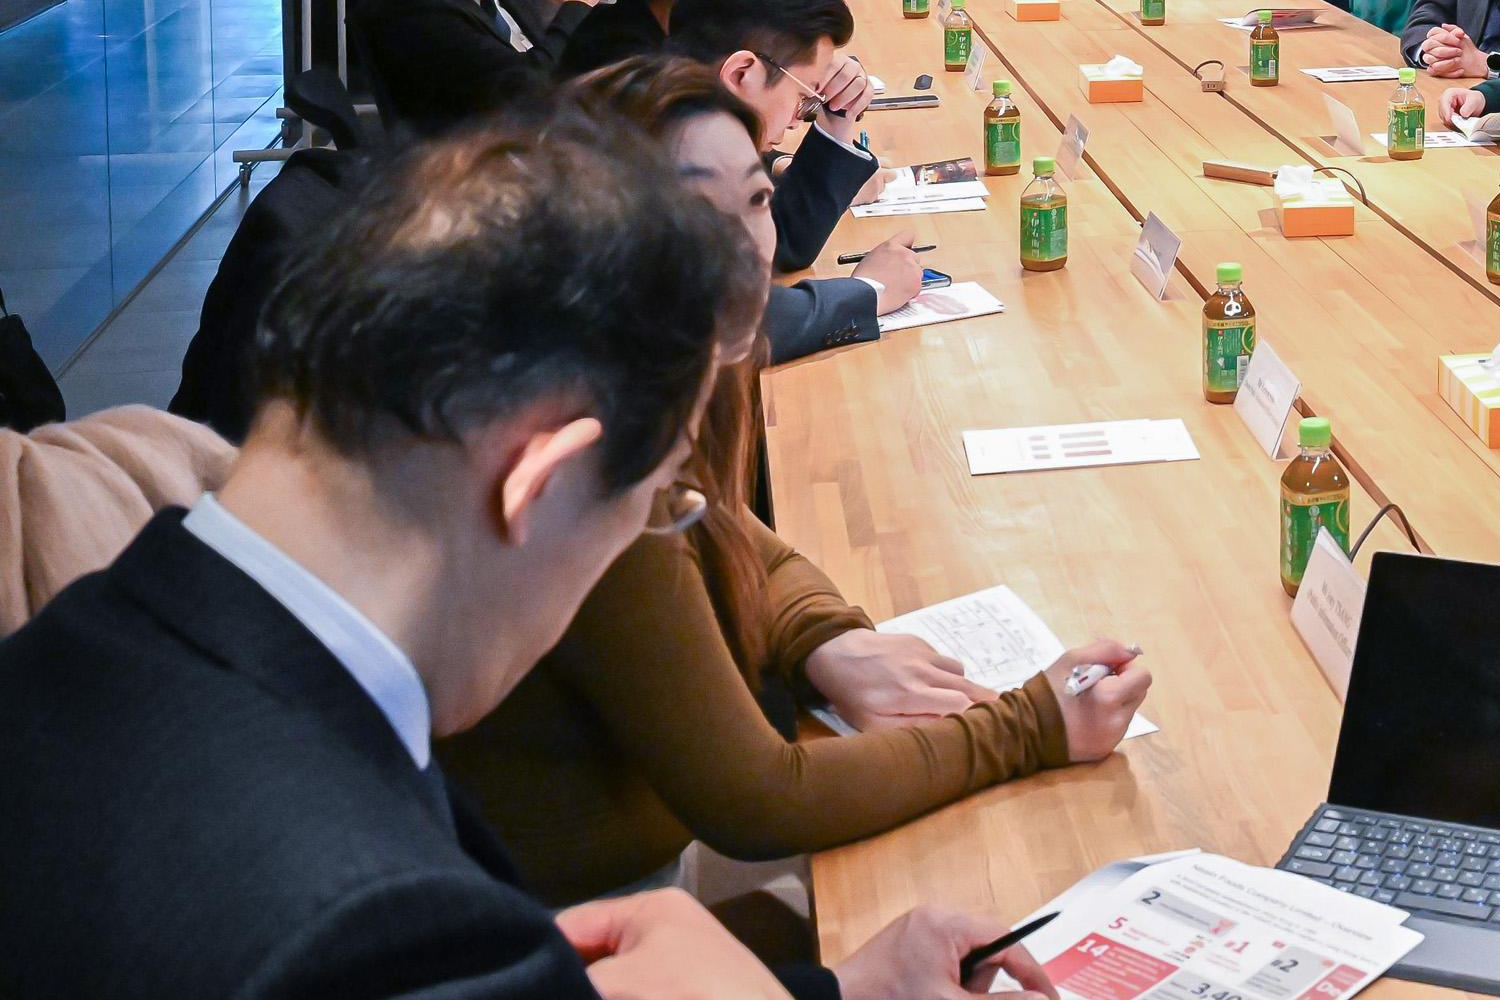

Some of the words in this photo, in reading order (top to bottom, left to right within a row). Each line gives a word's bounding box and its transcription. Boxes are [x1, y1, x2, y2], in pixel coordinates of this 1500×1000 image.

[1141, 890, 1161, 905] 2
[1108, 916, 1128, 929] 5
[1075, 939, 1111, 957] 14
